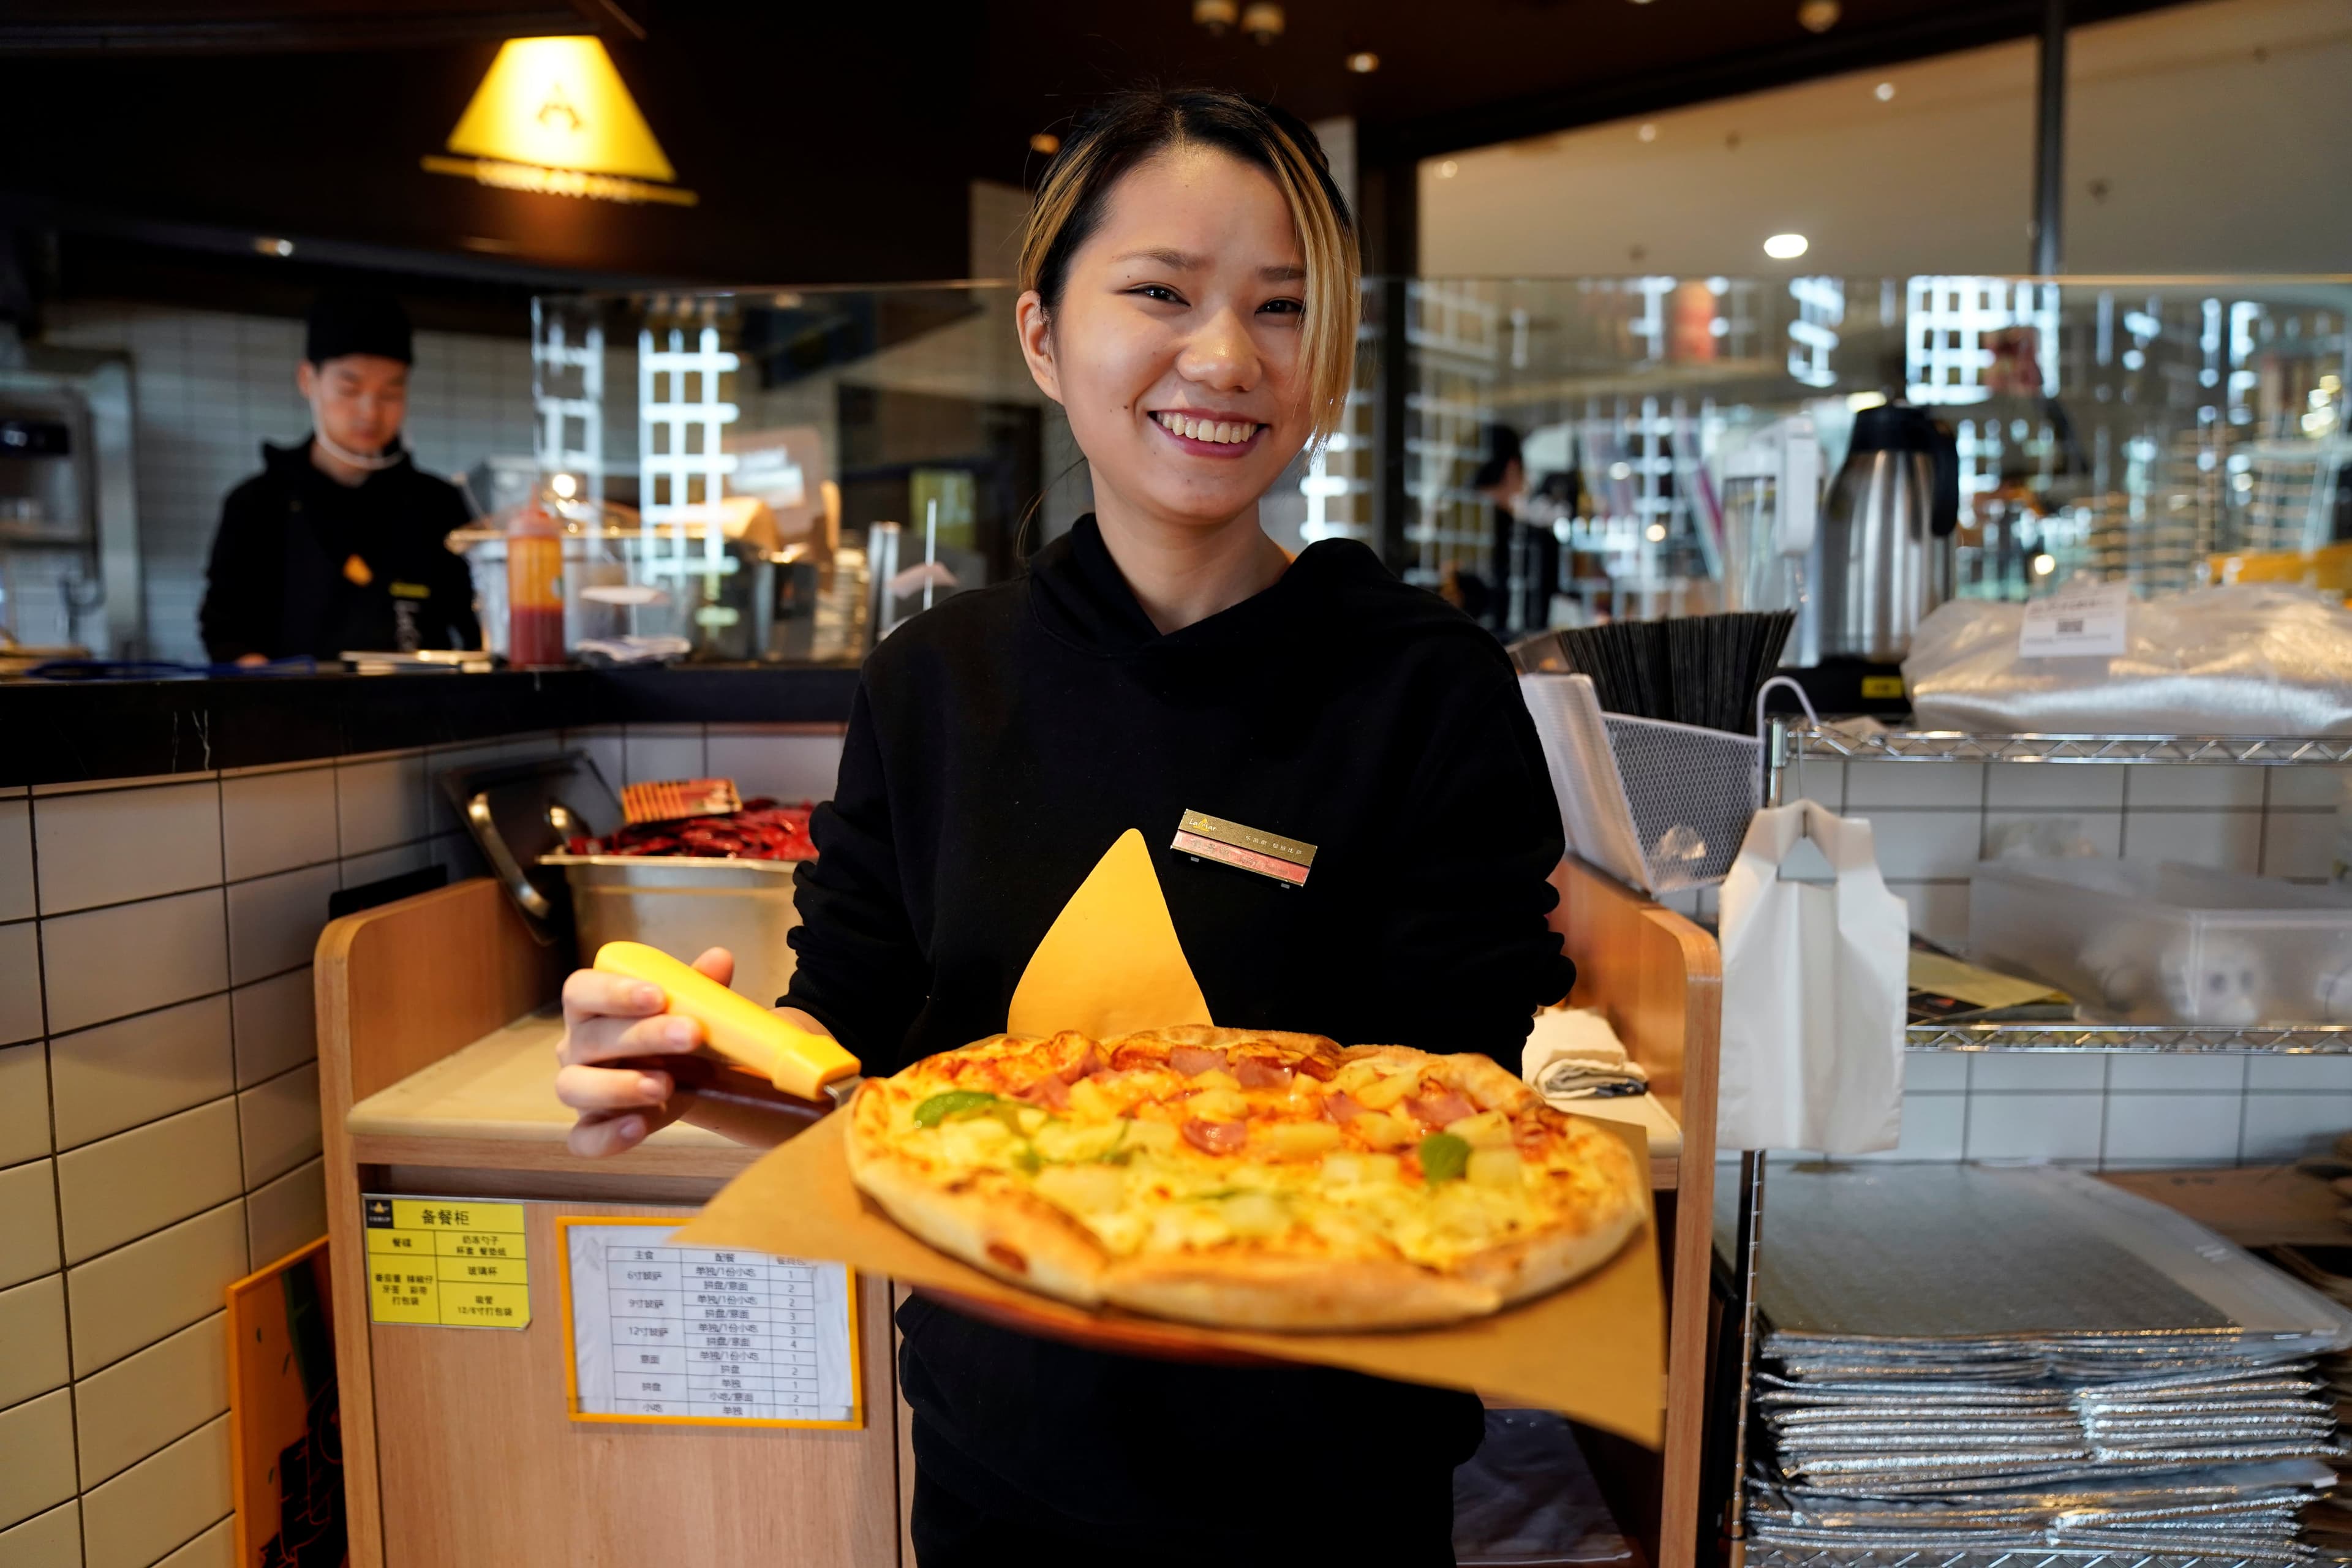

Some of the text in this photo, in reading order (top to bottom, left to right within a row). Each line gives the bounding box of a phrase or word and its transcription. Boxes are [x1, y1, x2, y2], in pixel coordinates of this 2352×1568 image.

[421, 1209, 468, 1225] 备餐柜
[635, 1251, 654, 1260] 主食
[788, 1284, 794, 1293] 2
[788, 1298, 796, 1308] 2
[790, 1312, 796, 1321] 3
[790, 1325, 797, 1335] 3
[790, 1340, 797, 1348] 4
[791, 1366, 798, 1376] 2
[793, 1394, 799, 1403] 2
